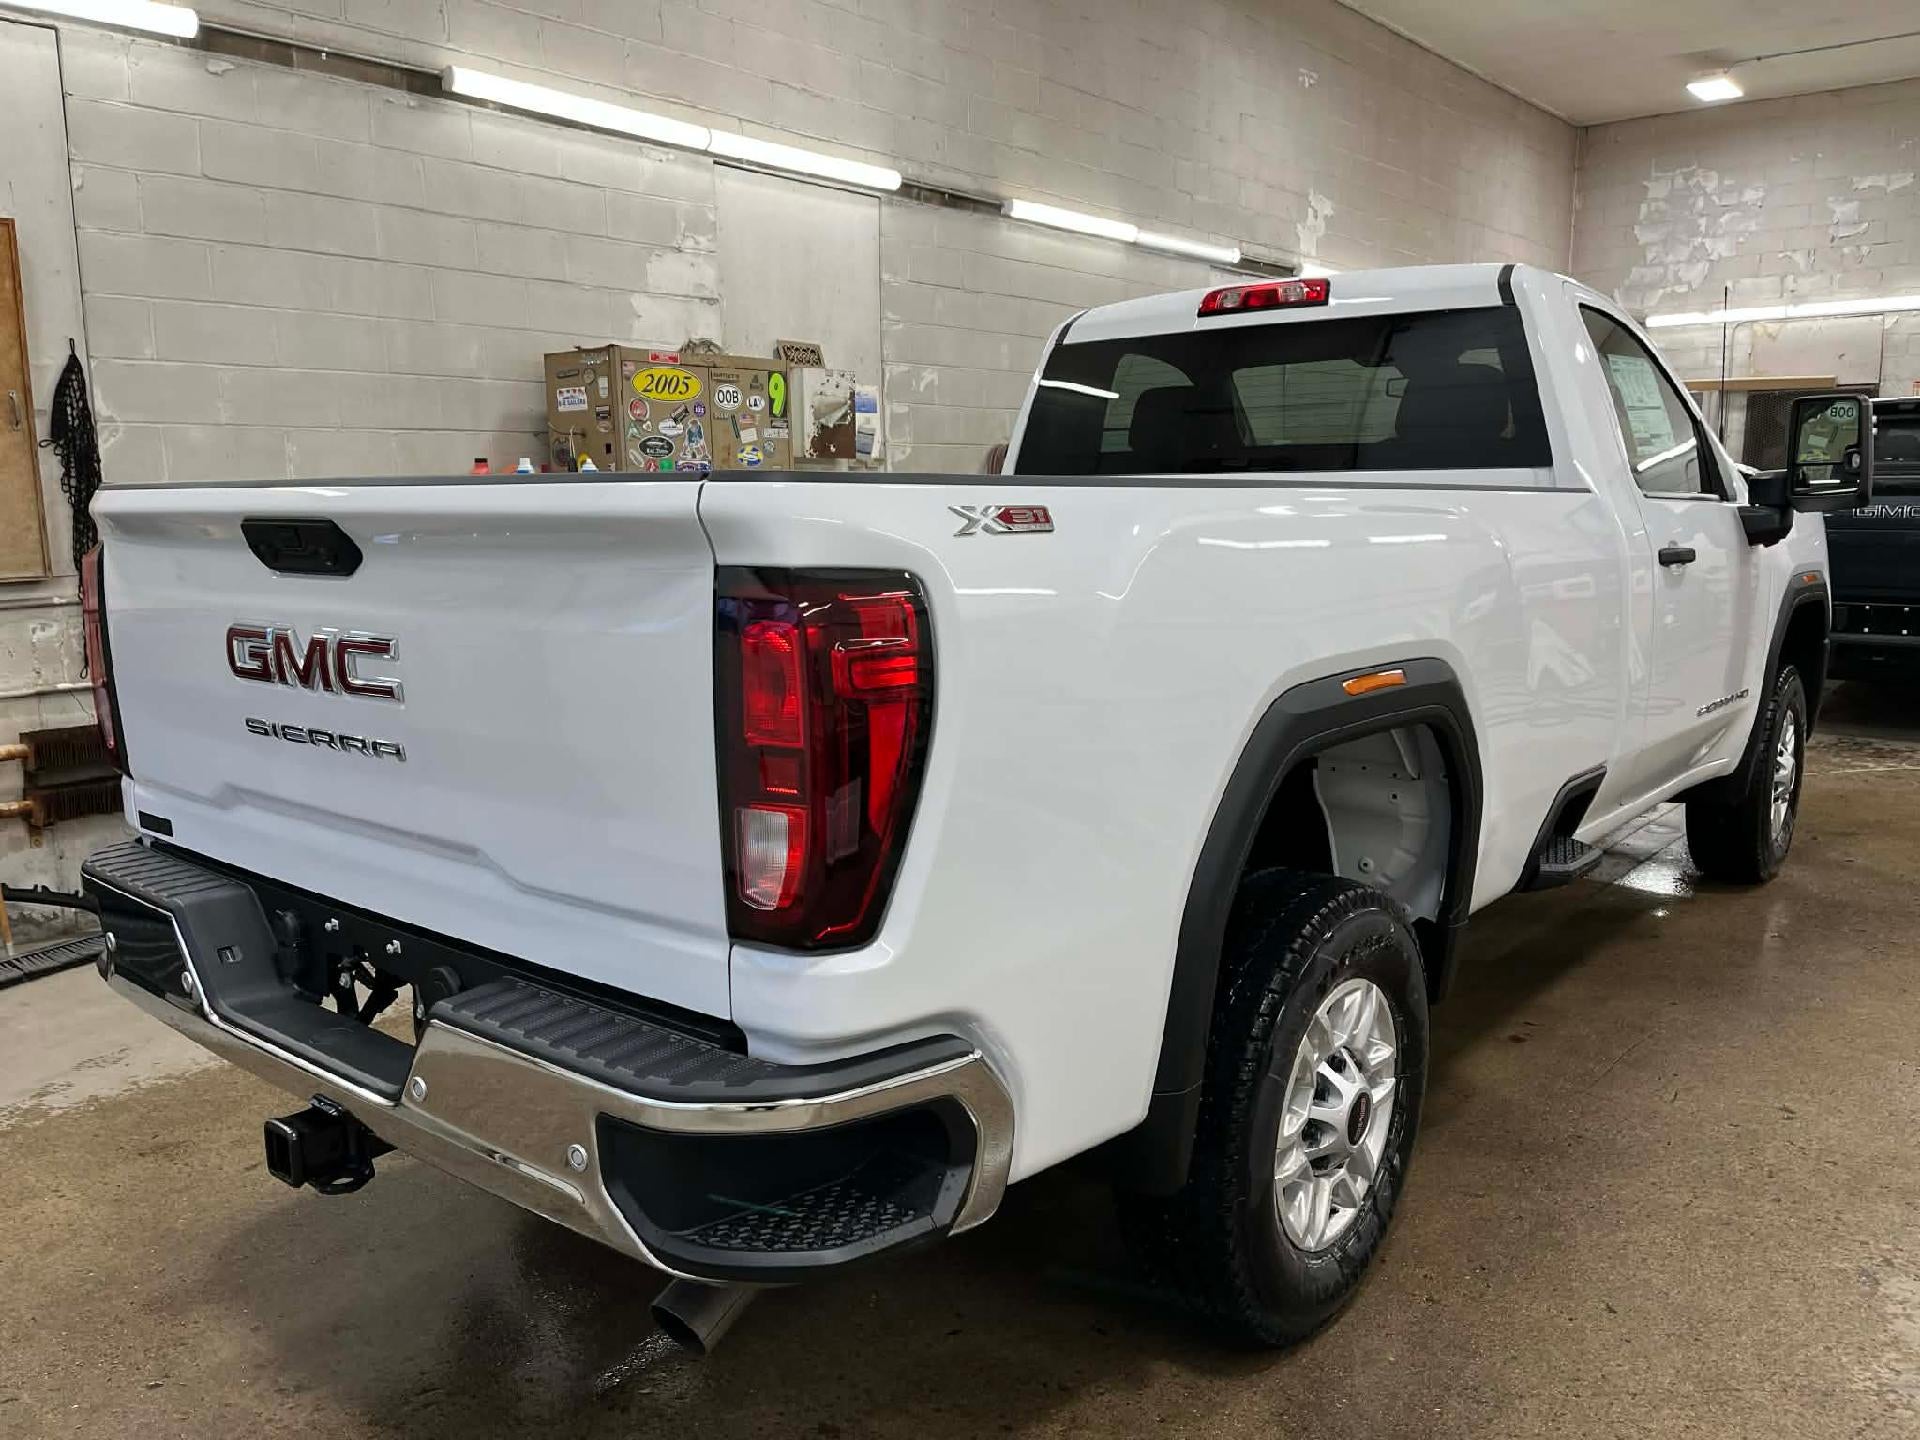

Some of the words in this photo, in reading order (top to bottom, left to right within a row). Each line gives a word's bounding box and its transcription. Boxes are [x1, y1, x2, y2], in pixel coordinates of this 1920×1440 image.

[642, 373, 693, 396] 2005
[717, 389, 740, 405] OOB
[769, 372, 786, 417] 9
[226, 622, 405, 704] GMC
[245, 716, 407, 762] SIERRA
